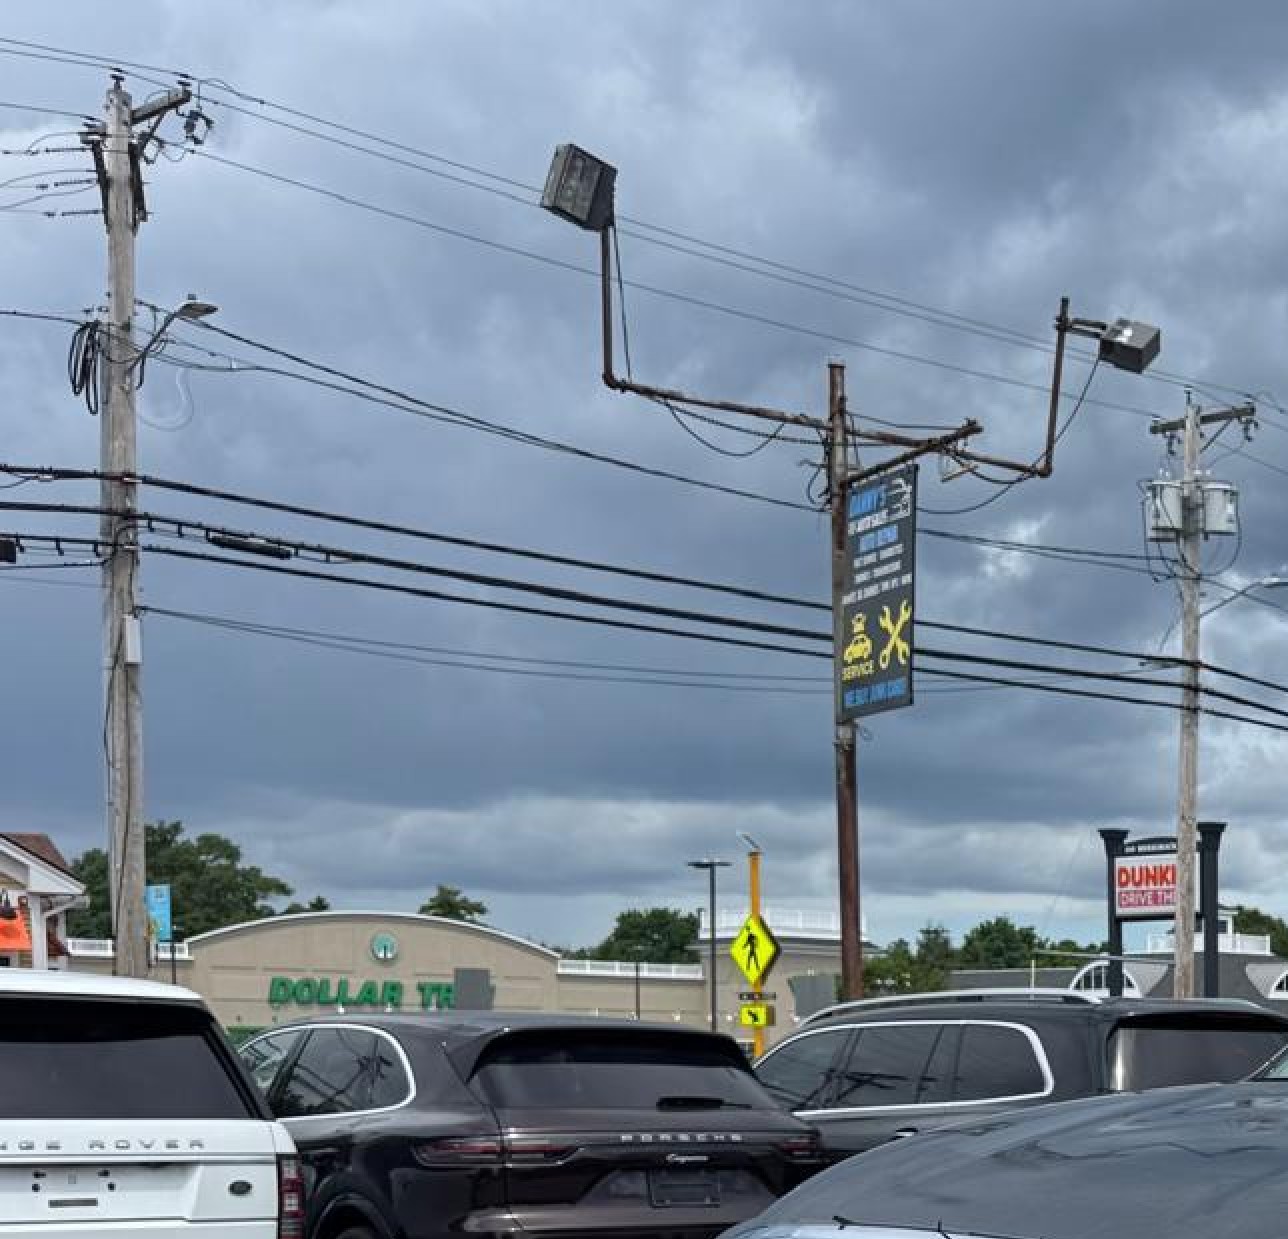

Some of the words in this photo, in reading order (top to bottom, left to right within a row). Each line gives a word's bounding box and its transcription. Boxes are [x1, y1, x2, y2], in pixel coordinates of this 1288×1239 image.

[1118, 864, 1177, 888] DUNKI
[269, 977, 403, 1009] DOLLAR
[416, 981, 456, 1010] TR
[88, 1138, 206, 1151] ROVER
[620, 1133, 742, 1143] PORSCHE
